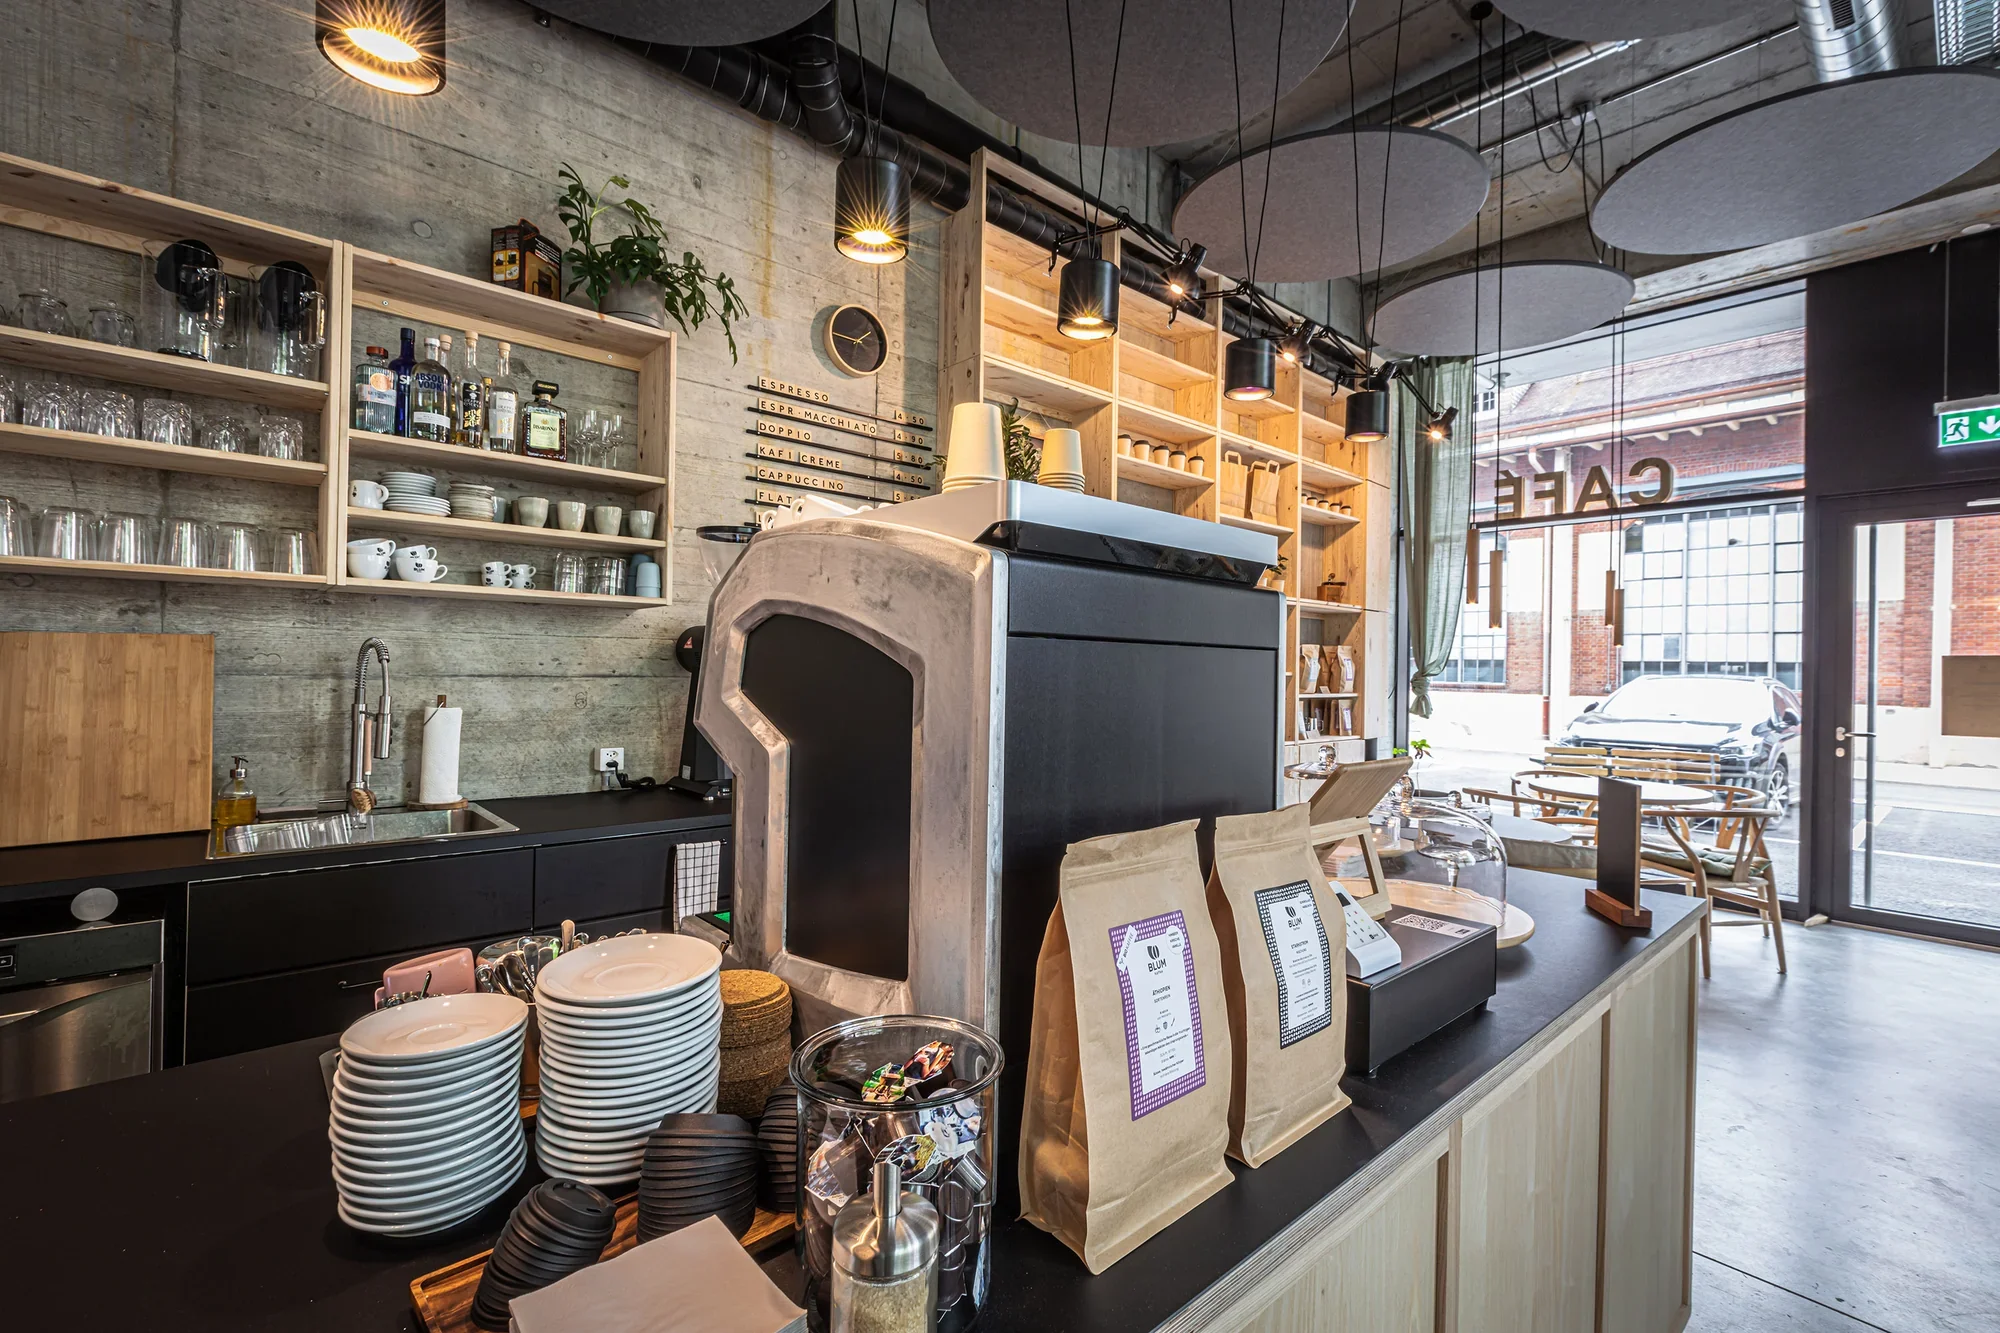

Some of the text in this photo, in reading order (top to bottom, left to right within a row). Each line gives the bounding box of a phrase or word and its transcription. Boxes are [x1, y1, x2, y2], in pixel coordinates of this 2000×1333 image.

[761, 379, 829, 402] ESPRESSO
[533, 423, 558, 432] DISARONNO
[759, 422, 811, 440] DOPPIO
[759, 446, 792, 459] KAFI
[801, 454, 841, 469] CREME
[759, 469, 844, 490] CAPPUCCINO
[759, 491, 792, 504] FLAT
[1287, 917, 1303, 928] BLUM
[1147, 958, 1167, 973] BLUM
